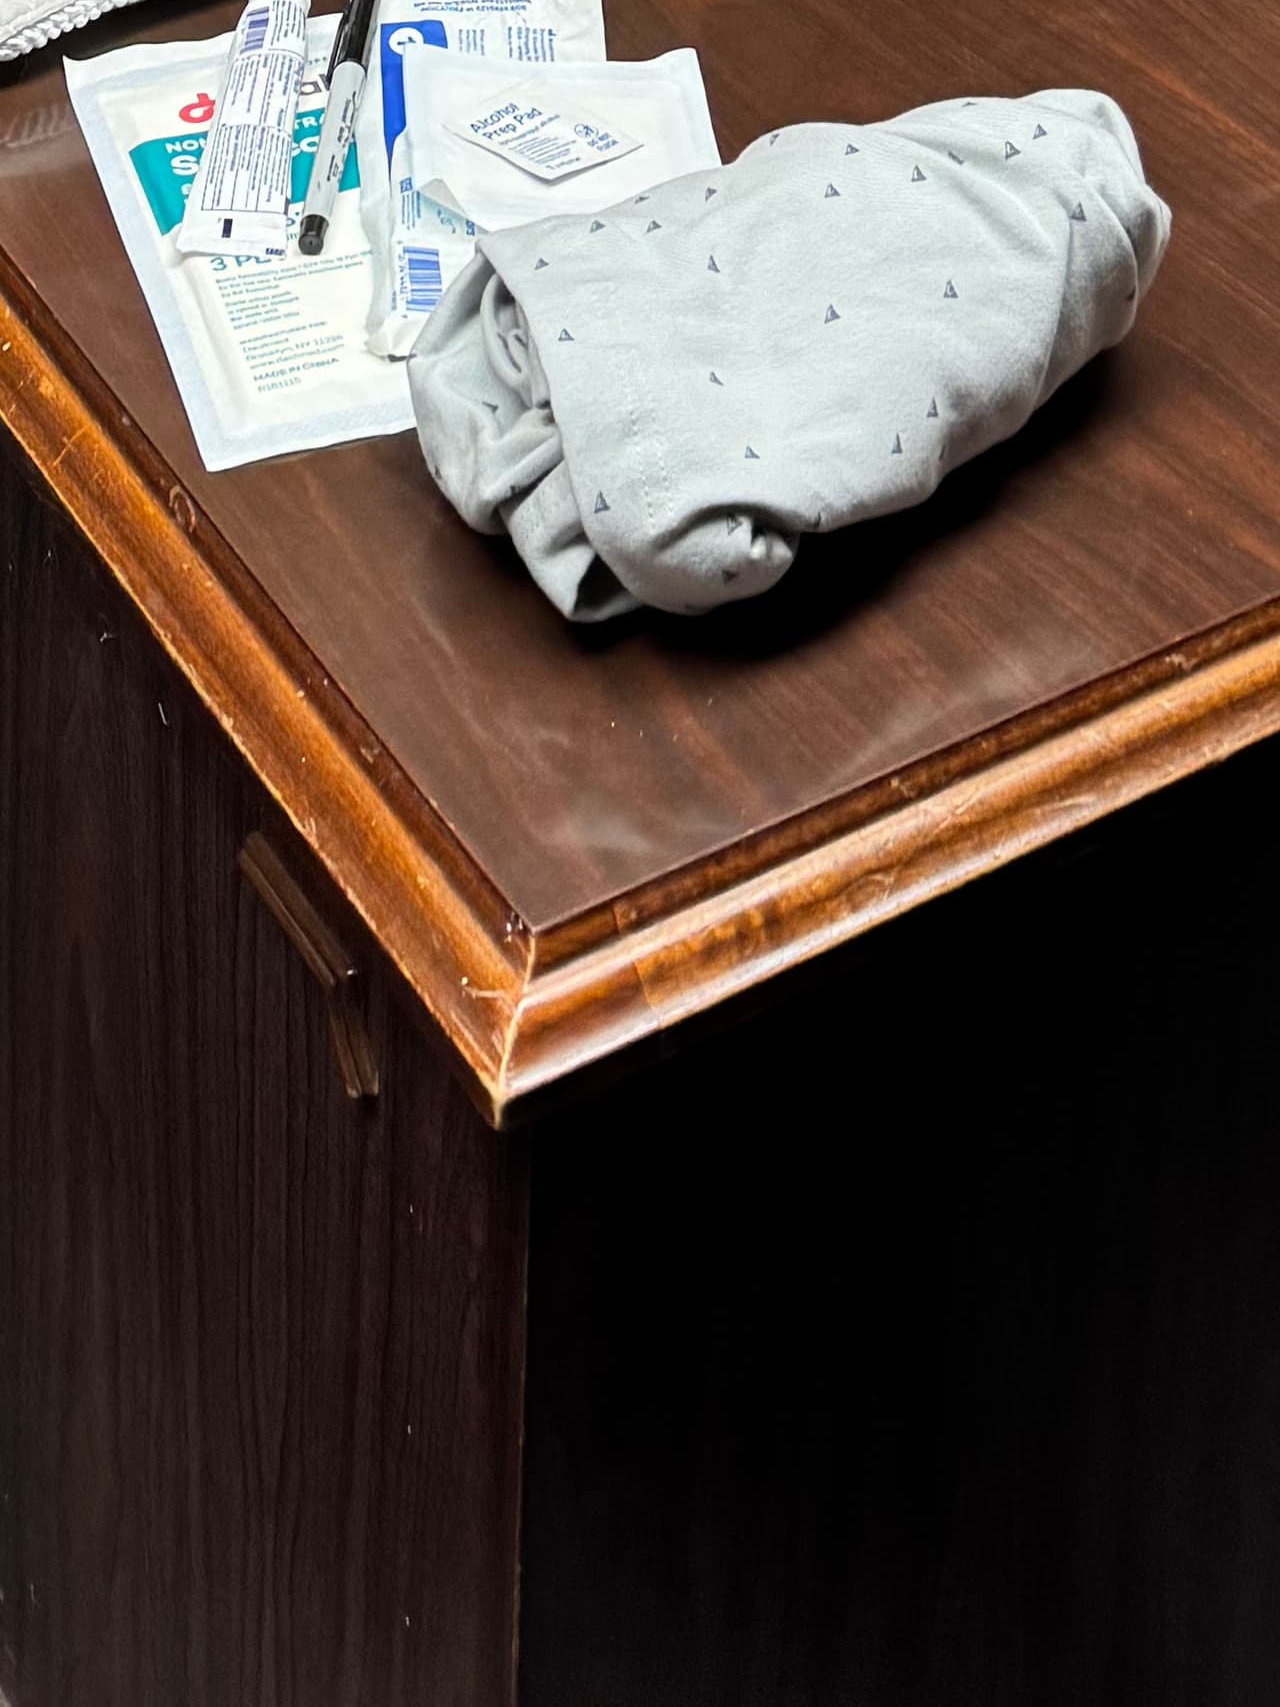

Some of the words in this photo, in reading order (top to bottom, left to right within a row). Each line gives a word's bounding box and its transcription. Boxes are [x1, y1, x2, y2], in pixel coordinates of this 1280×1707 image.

[470, 102, 521, 134] Alcohol
[482, 122, 518, 141] Prep
[513, 107, 544, 125] Pad
[253, 368, 287, 382] MADE
[303, 357, 339, 370] CHINA
